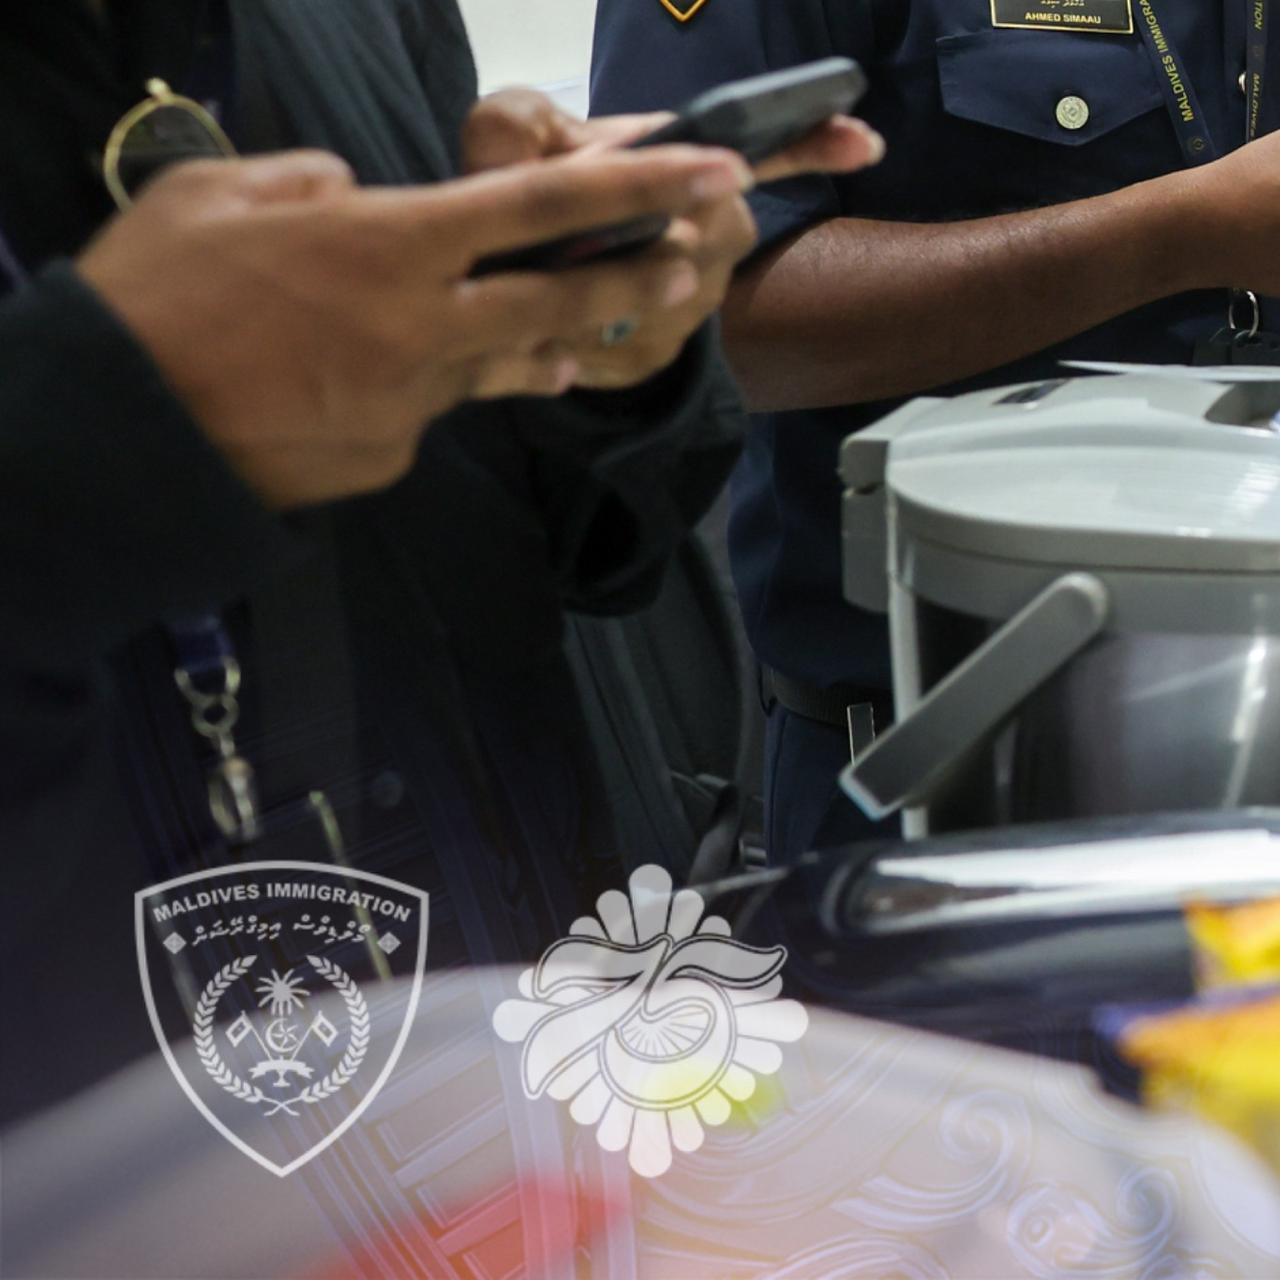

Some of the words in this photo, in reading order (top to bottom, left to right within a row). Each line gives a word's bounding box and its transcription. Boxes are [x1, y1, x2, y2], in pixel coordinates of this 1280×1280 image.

[1025, 12, 1061, 22] AHMED
[1063, 14, 1102, 24] SIMAAU
[1162, 53, 1195, 122] MALDIVES
